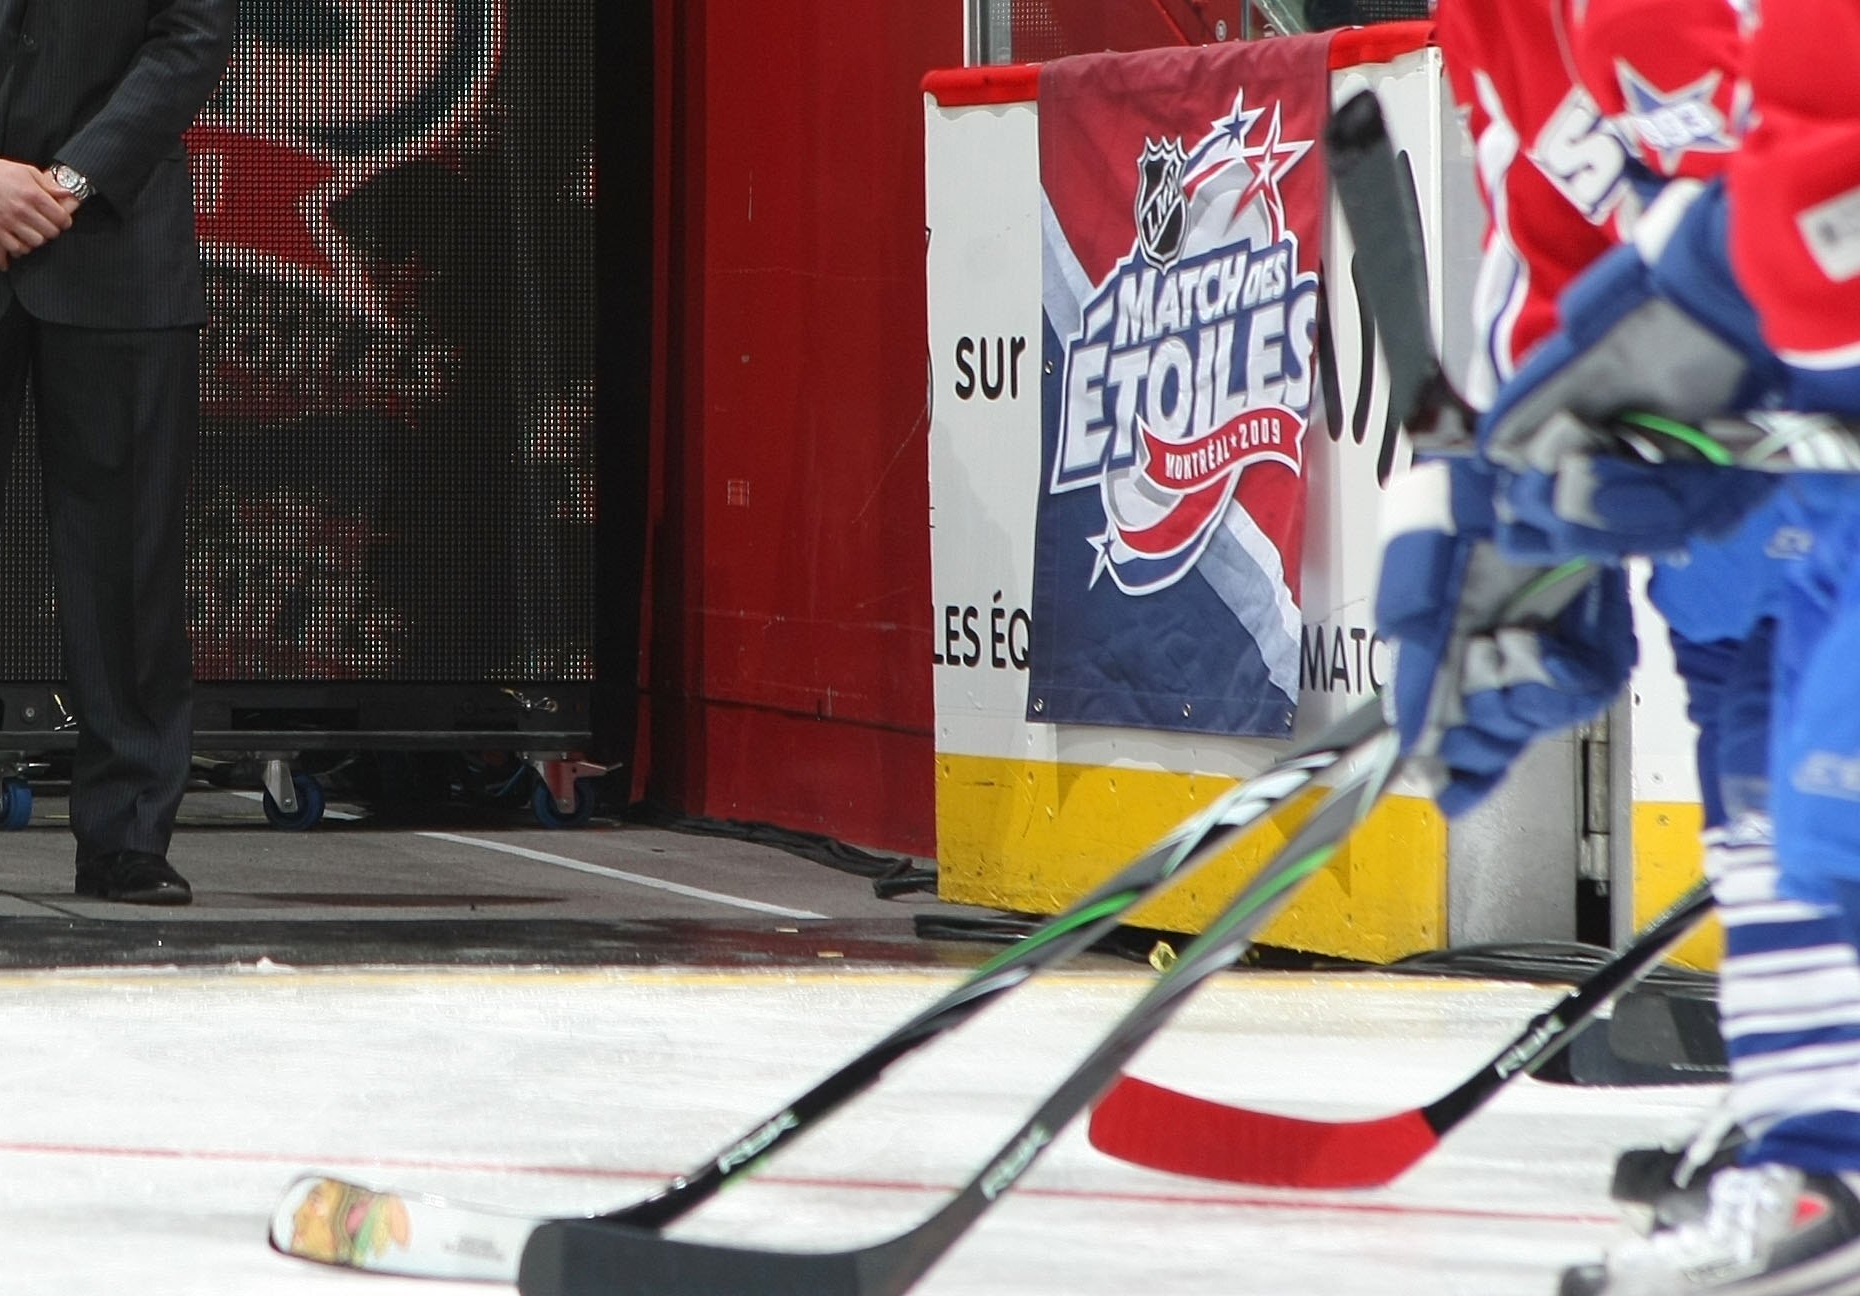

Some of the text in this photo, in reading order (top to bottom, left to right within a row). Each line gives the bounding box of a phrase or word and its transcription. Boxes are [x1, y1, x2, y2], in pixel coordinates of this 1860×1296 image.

[1146, 166, 1179, 240] LNH
[1113, 248, 1288, 350] MATCH DES
[955, 336, 1026, 400] sur
[1063, 290, 1318, 473] ÉTOILES
[1164, 417, 1282, 481] MONTRÉAL 2009
